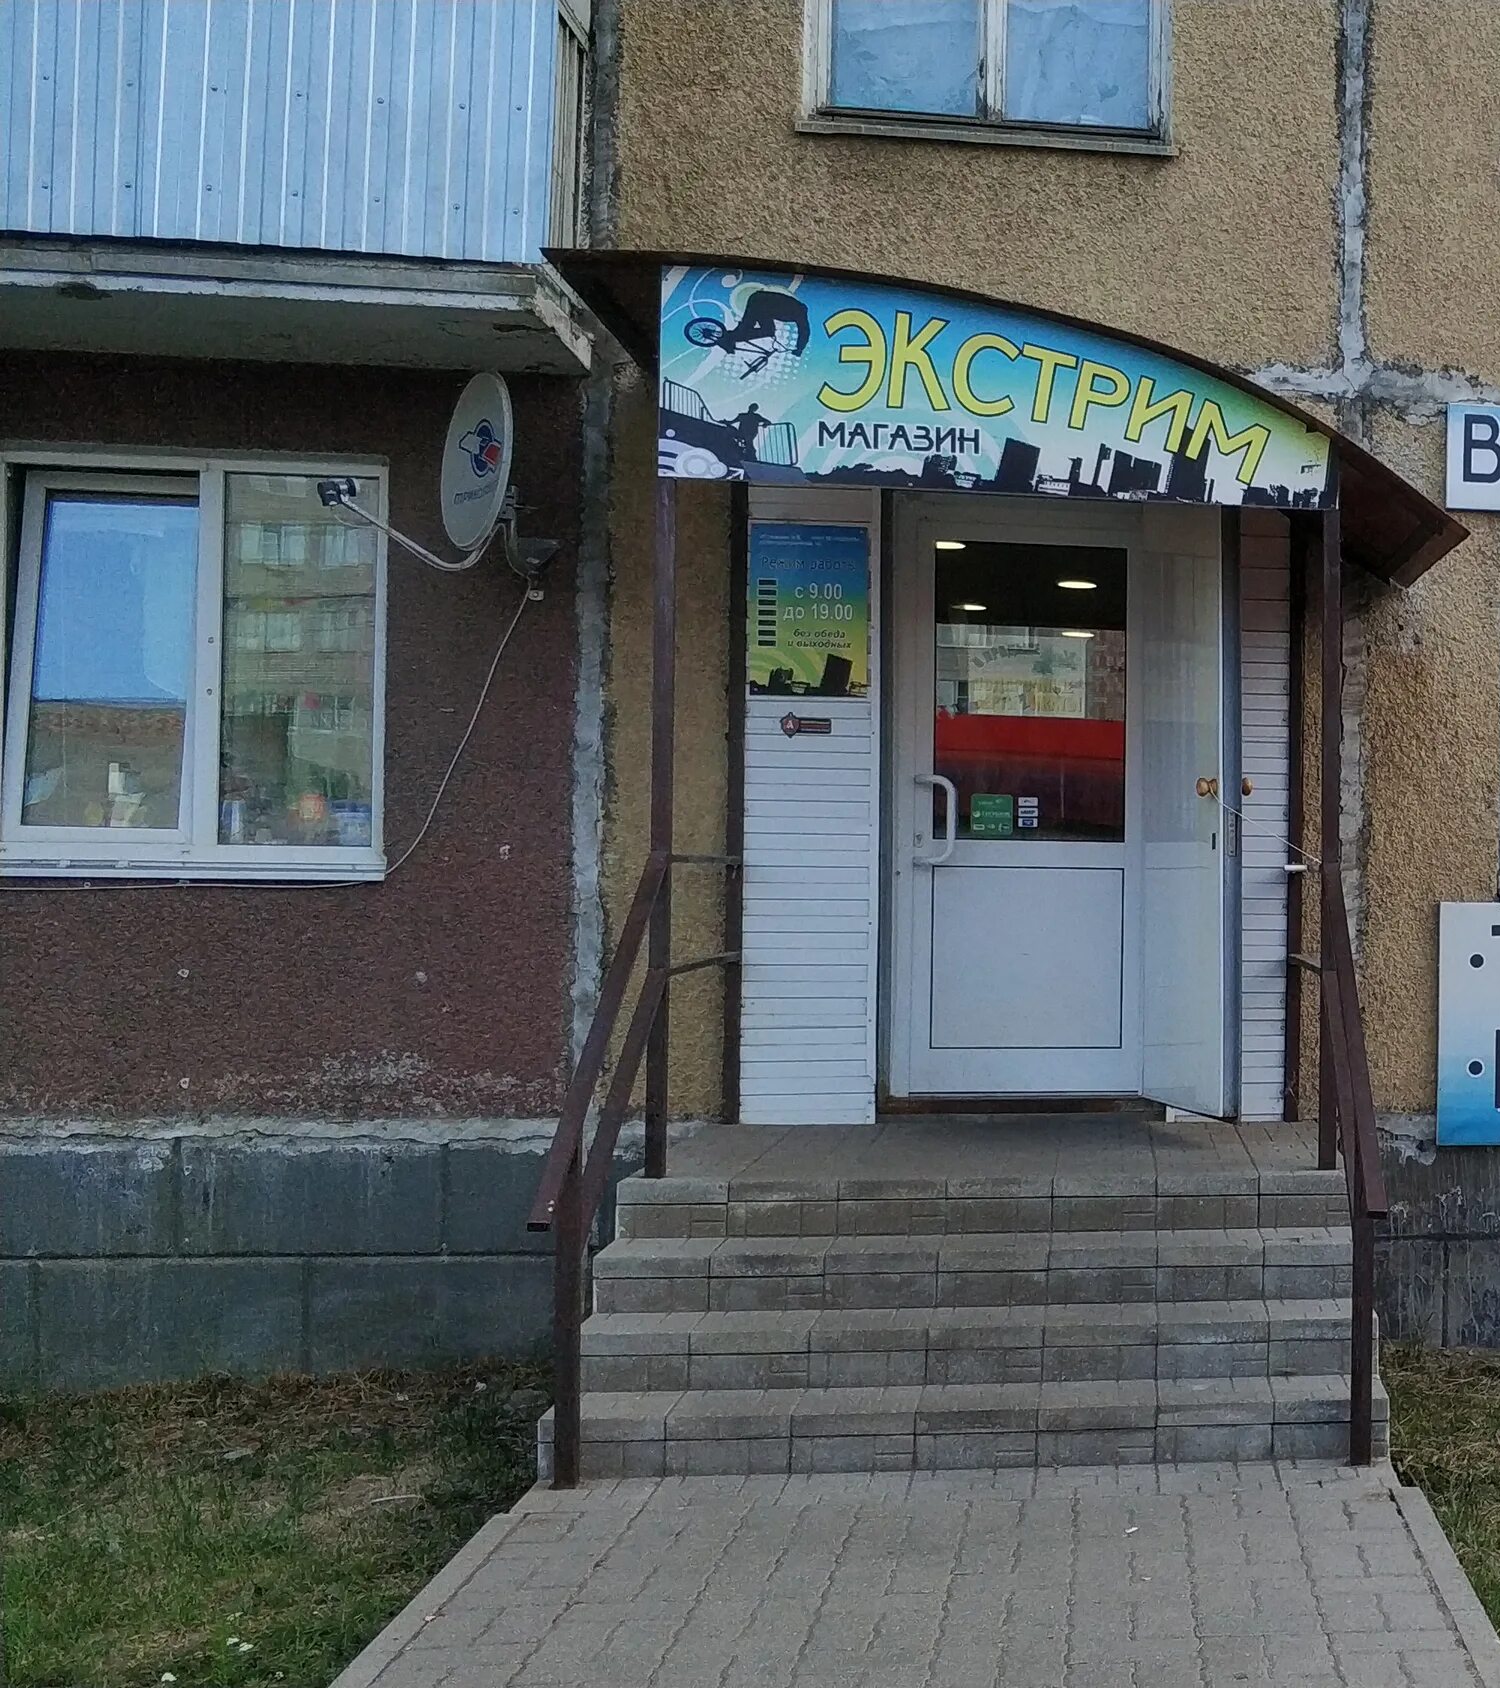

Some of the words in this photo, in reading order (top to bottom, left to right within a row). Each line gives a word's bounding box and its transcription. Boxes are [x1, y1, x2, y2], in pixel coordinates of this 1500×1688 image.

[818, 308, 1271, 485] ЭКСТРИМ
[817, 419, 981, 456] МАГАЗИН
[794, 586, 804, 599] с
[809, 582, 842, 600] 9.00
[783, 606, 805, 621] до
[811, 603, 853, 621] 19.00
[814, 629, 846, 639] обеда
[796, 639, 852, 649] выходных
